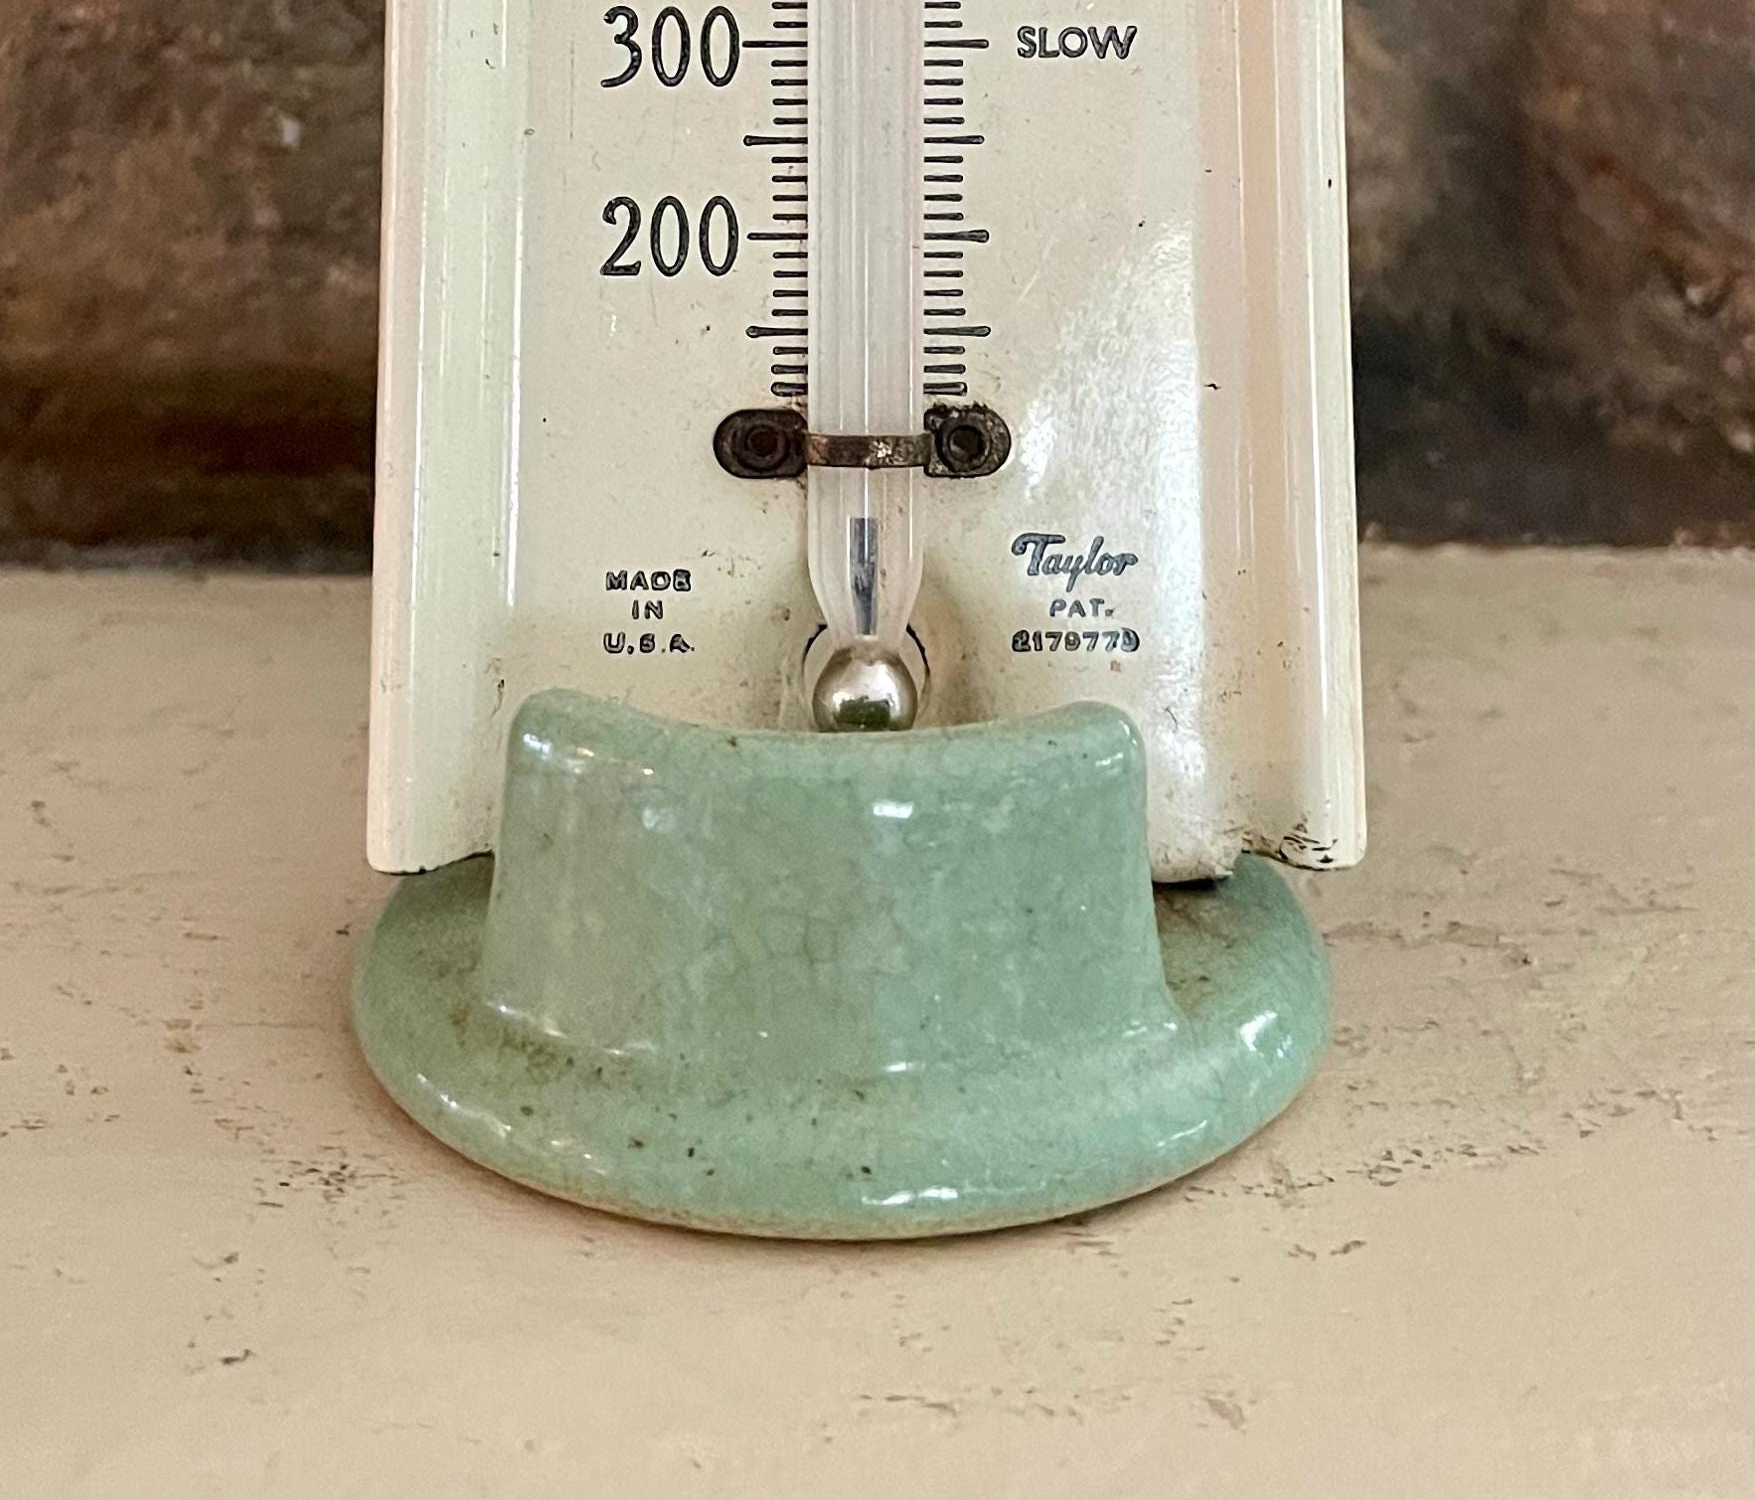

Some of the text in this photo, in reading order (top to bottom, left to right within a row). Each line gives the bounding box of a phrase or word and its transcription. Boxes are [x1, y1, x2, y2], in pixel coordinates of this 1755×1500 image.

[599, 5, 741, 89] 300
[1016, 25, 1138, 61] SLOW
[599, 195, 739, 278] 200
[1011, 532, 1139, 593] Taylor
[605, 568, 693, 593] MADE
[631, 599, 665, 620] IN
[1049, 597, 1114, 619] PAT.
[602, 631, 696, 656] U.S.A.
